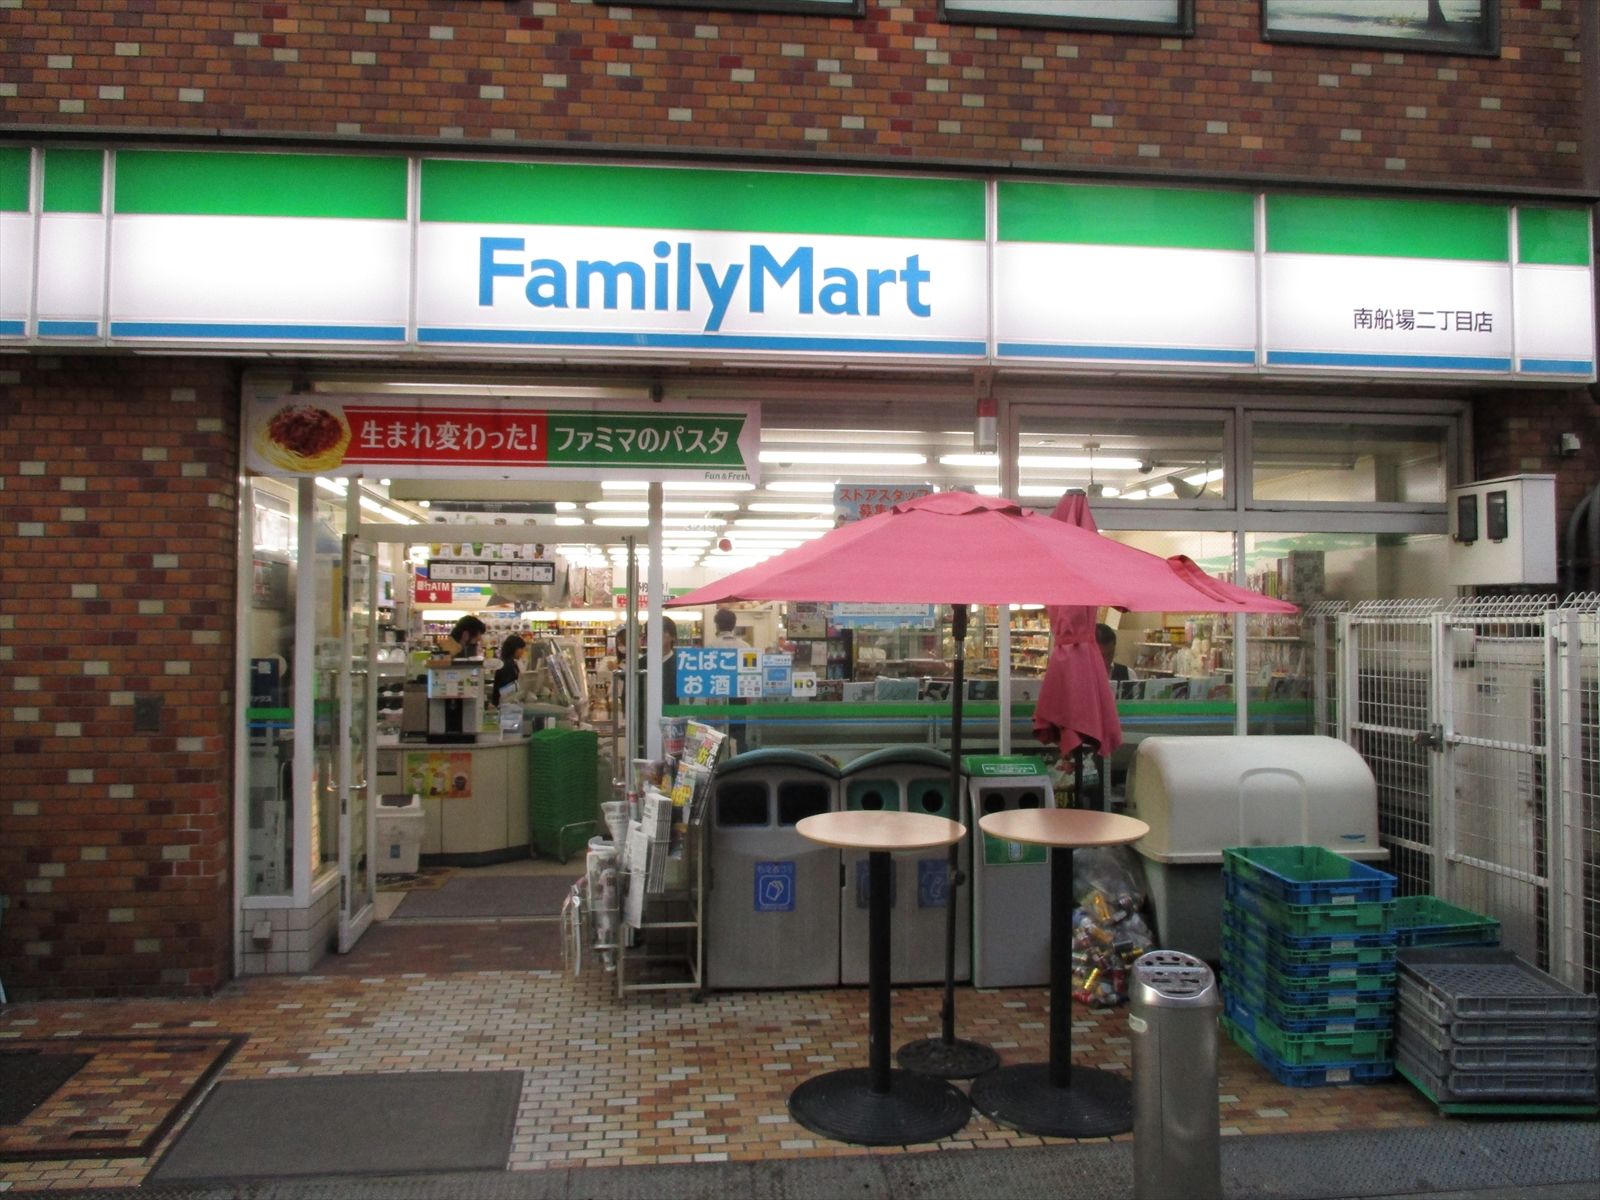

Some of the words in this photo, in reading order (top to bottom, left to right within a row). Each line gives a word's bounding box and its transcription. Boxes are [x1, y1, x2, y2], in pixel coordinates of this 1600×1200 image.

[479, 236, 931, 336] FamilyMart
[1353, 307, 1493, 333] 南船場二丁目店
[359, 419, 538, 452] 生まれ変わった!
[554, 424, 729, 455] ファミマのパスタ
[704, 471, 721, 480] Fun
[728, 471, 751, 481] Fresh
[678, 650, 737, 671] たばこ
[683, 675, 731, 695] お酒
